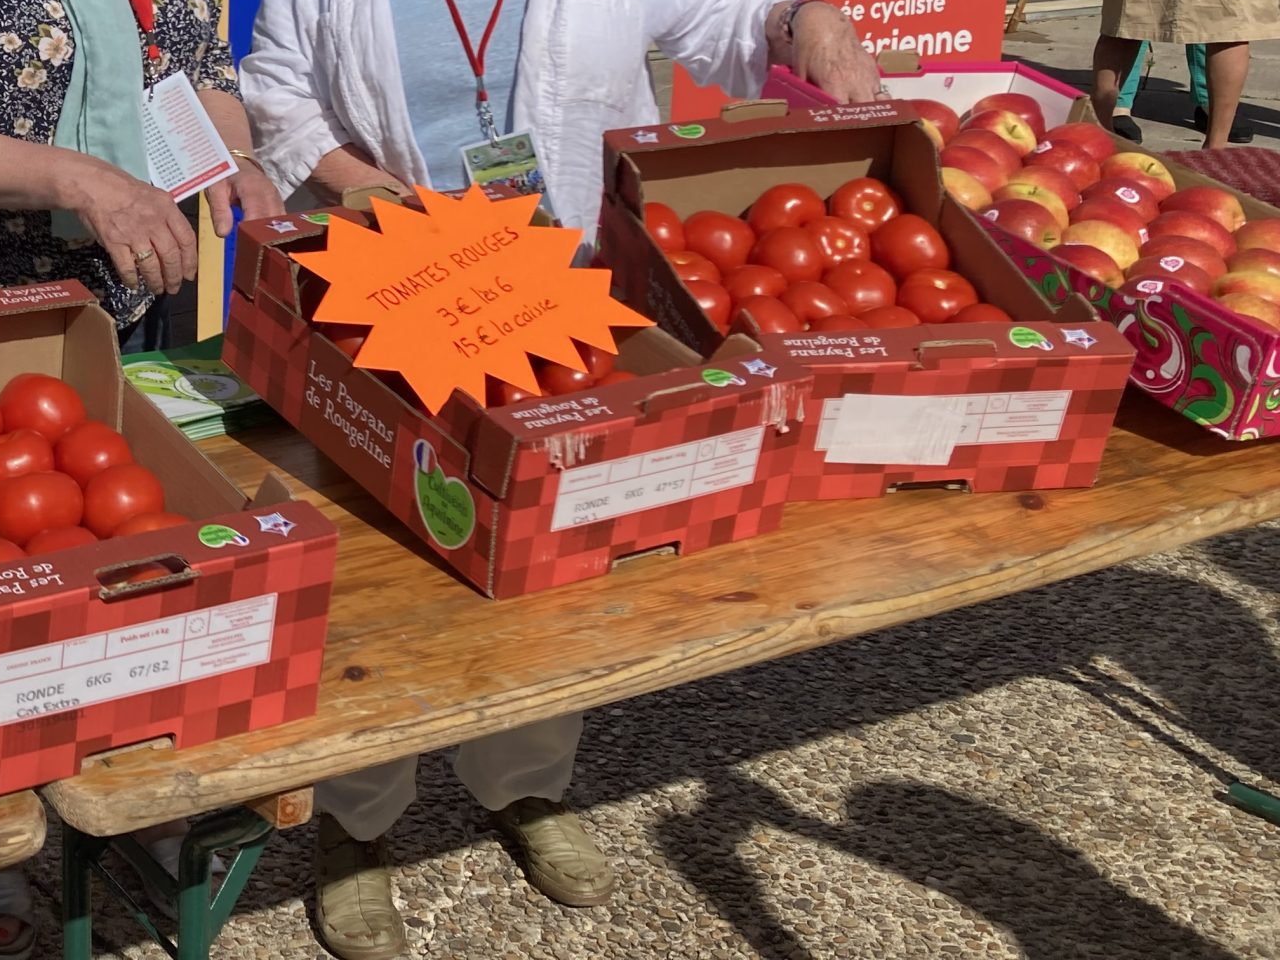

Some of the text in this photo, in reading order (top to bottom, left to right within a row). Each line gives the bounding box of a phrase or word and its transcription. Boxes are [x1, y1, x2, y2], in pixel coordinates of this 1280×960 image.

[366, 226, 520, 312] TOMATES ROUGES
[3, 285, 63, 299] Paysans
[502, 277, 515, 295] 6
[0, 289, 71, 306] Rougeline
[514, 298, 560, 329] caisse
[308, 360, 395, 444] Les Paysans
[305, 385, 392, 469] de Rougeline
[573, 496, 611, 513] RONDE
[32, 562, 54, 575] de
[31, 573, 64, 589] Les
[16, 660, 170, 704] RONDE 6KG 67/82
